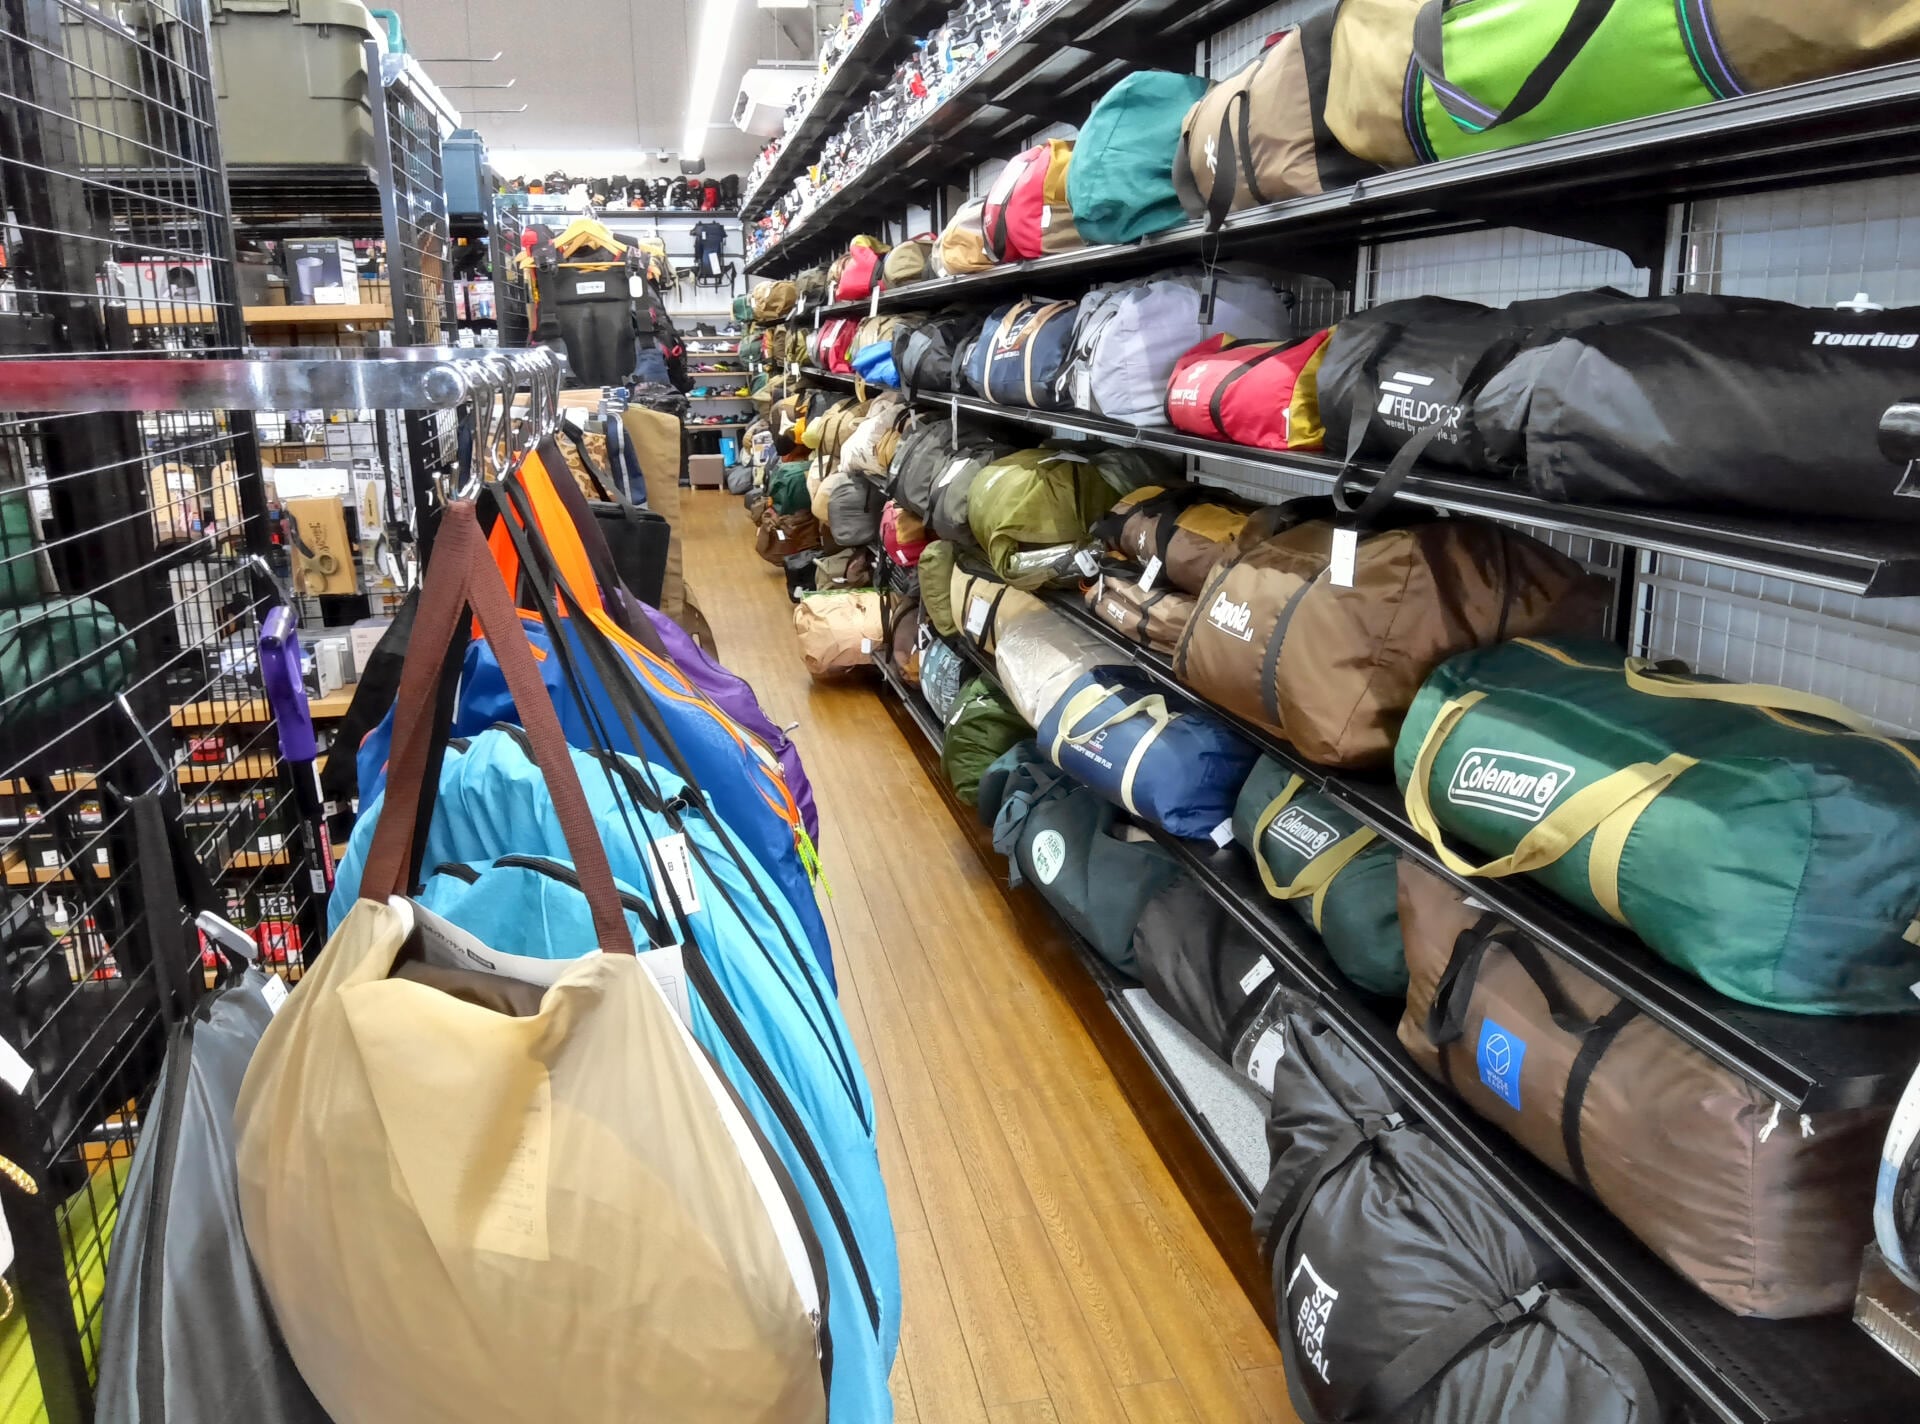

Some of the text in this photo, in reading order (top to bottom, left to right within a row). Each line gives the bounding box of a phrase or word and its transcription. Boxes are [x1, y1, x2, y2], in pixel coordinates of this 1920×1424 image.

[1812, 331, 1919, 349] Touring
[1459, 755, 1538, 798] Coleman
[1277, 810, 1318, 843] Coleman
[1299, 1296, 1325, 1348] BBA
[1311, 1286, 1333, 1324] SA
[1297, 1314, 1330, 1385] TICAL
